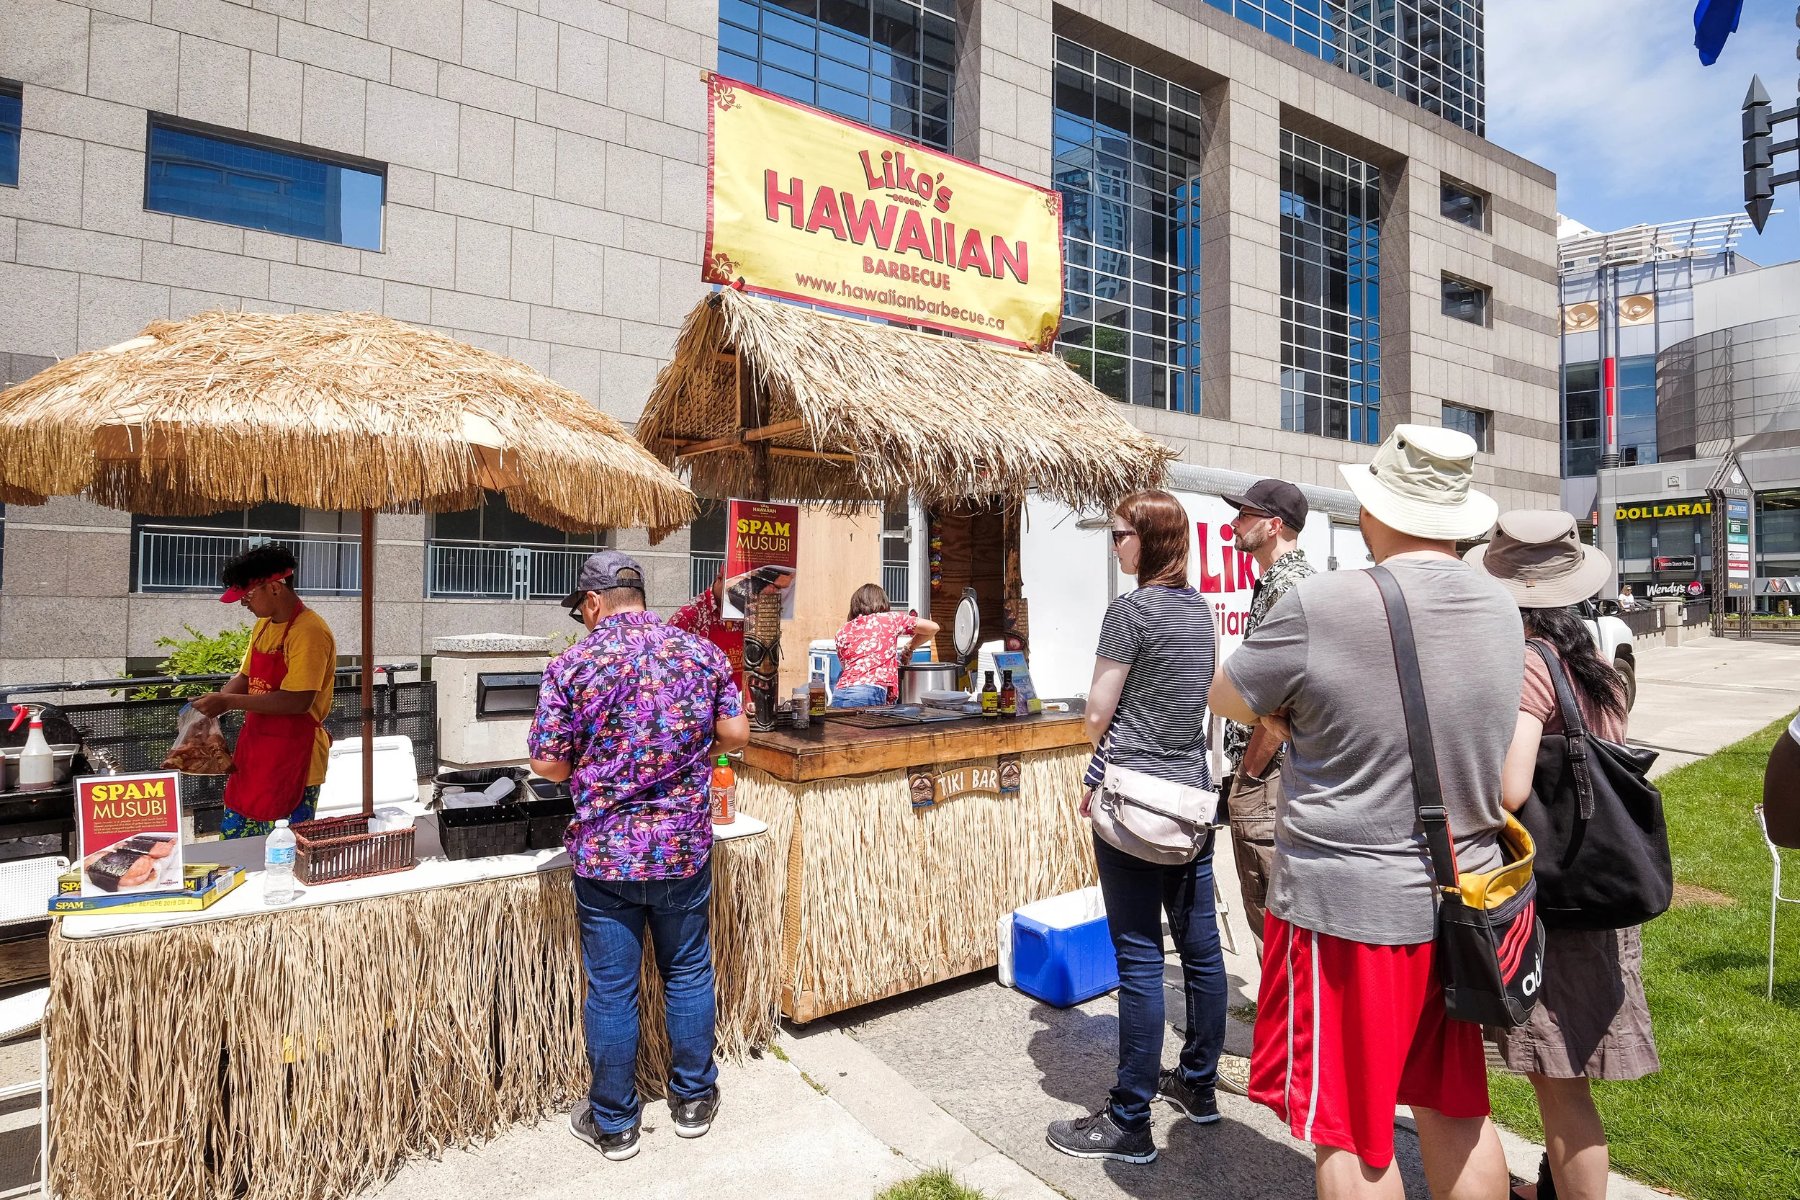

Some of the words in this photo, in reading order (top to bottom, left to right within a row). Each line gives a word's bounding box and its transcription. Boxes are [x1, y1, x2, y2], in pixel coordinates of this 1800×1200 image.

[858, 149, 953, 213] Liko's
[764, 169, 1029, 284] HAWAIIAN
[862, 255, 951, 291] BARBECUE
[795, 272, 1005, 331] www.hawaiianbarbecue.ca
[737, 519, 790, 537] SPAM
[736, 536, 790, 552] MUSUBI
[1196, 522, 1256, 593] Lik
[1646, 582, 1686, 597] Wendy's
[91, 781, 166, 802] SPAM
[938, 771, 964, 796] TIKI
[972, 769, 998, 789] BAR
[93, 799, 167, 819] MUSUBI
[60, 881, 81, 891] SPA
[55, 901, 84, 910] SPAM
